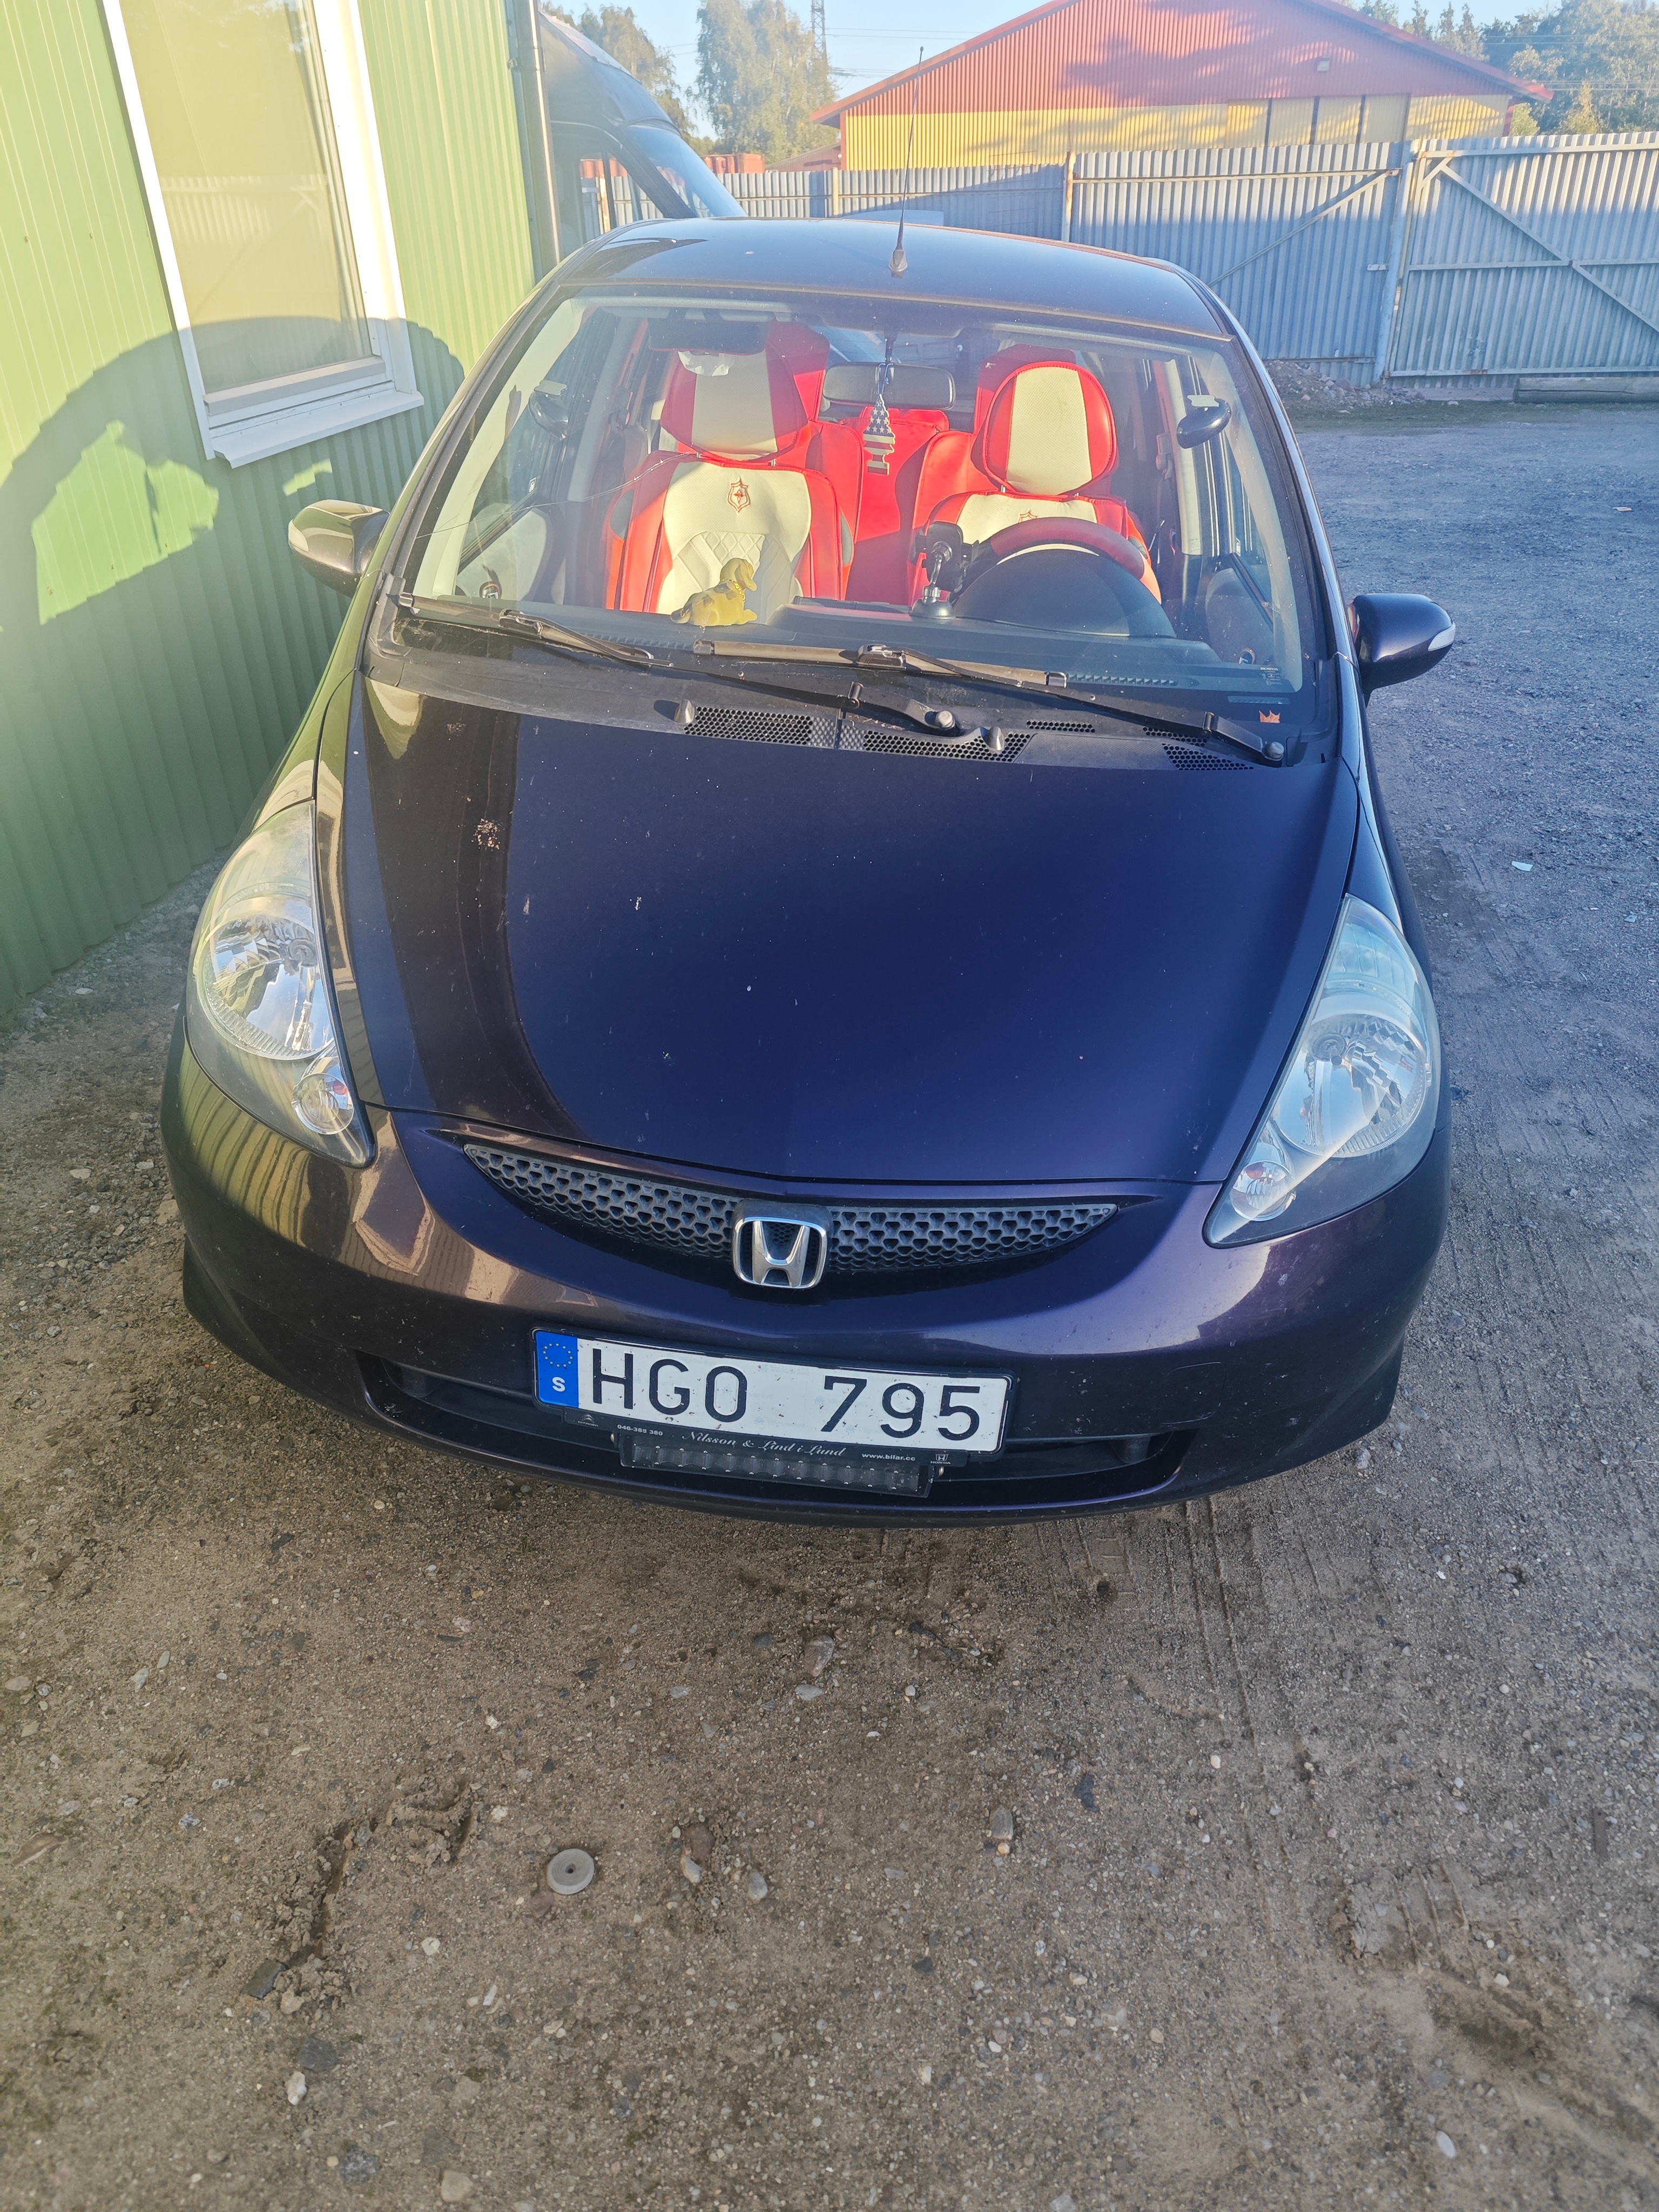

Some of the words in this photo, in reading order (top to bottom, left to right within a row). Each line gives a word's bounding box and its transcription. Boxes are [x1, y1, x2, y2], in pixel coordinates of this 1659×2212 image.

[552, 1377, 565, 1392] S
[592, 1348, 747, 1422] HGO
[820, 1375, 980, 1441] 795
[617, 1424, 647, 1434] 046-385
[682, 1432, 737, 1447] Nilsson
[758, 1440, 796, 1452] Lind
[804, 1445, 847, 1456] Lund
[861, 1453, 916, 1461] www.bilar.cc
